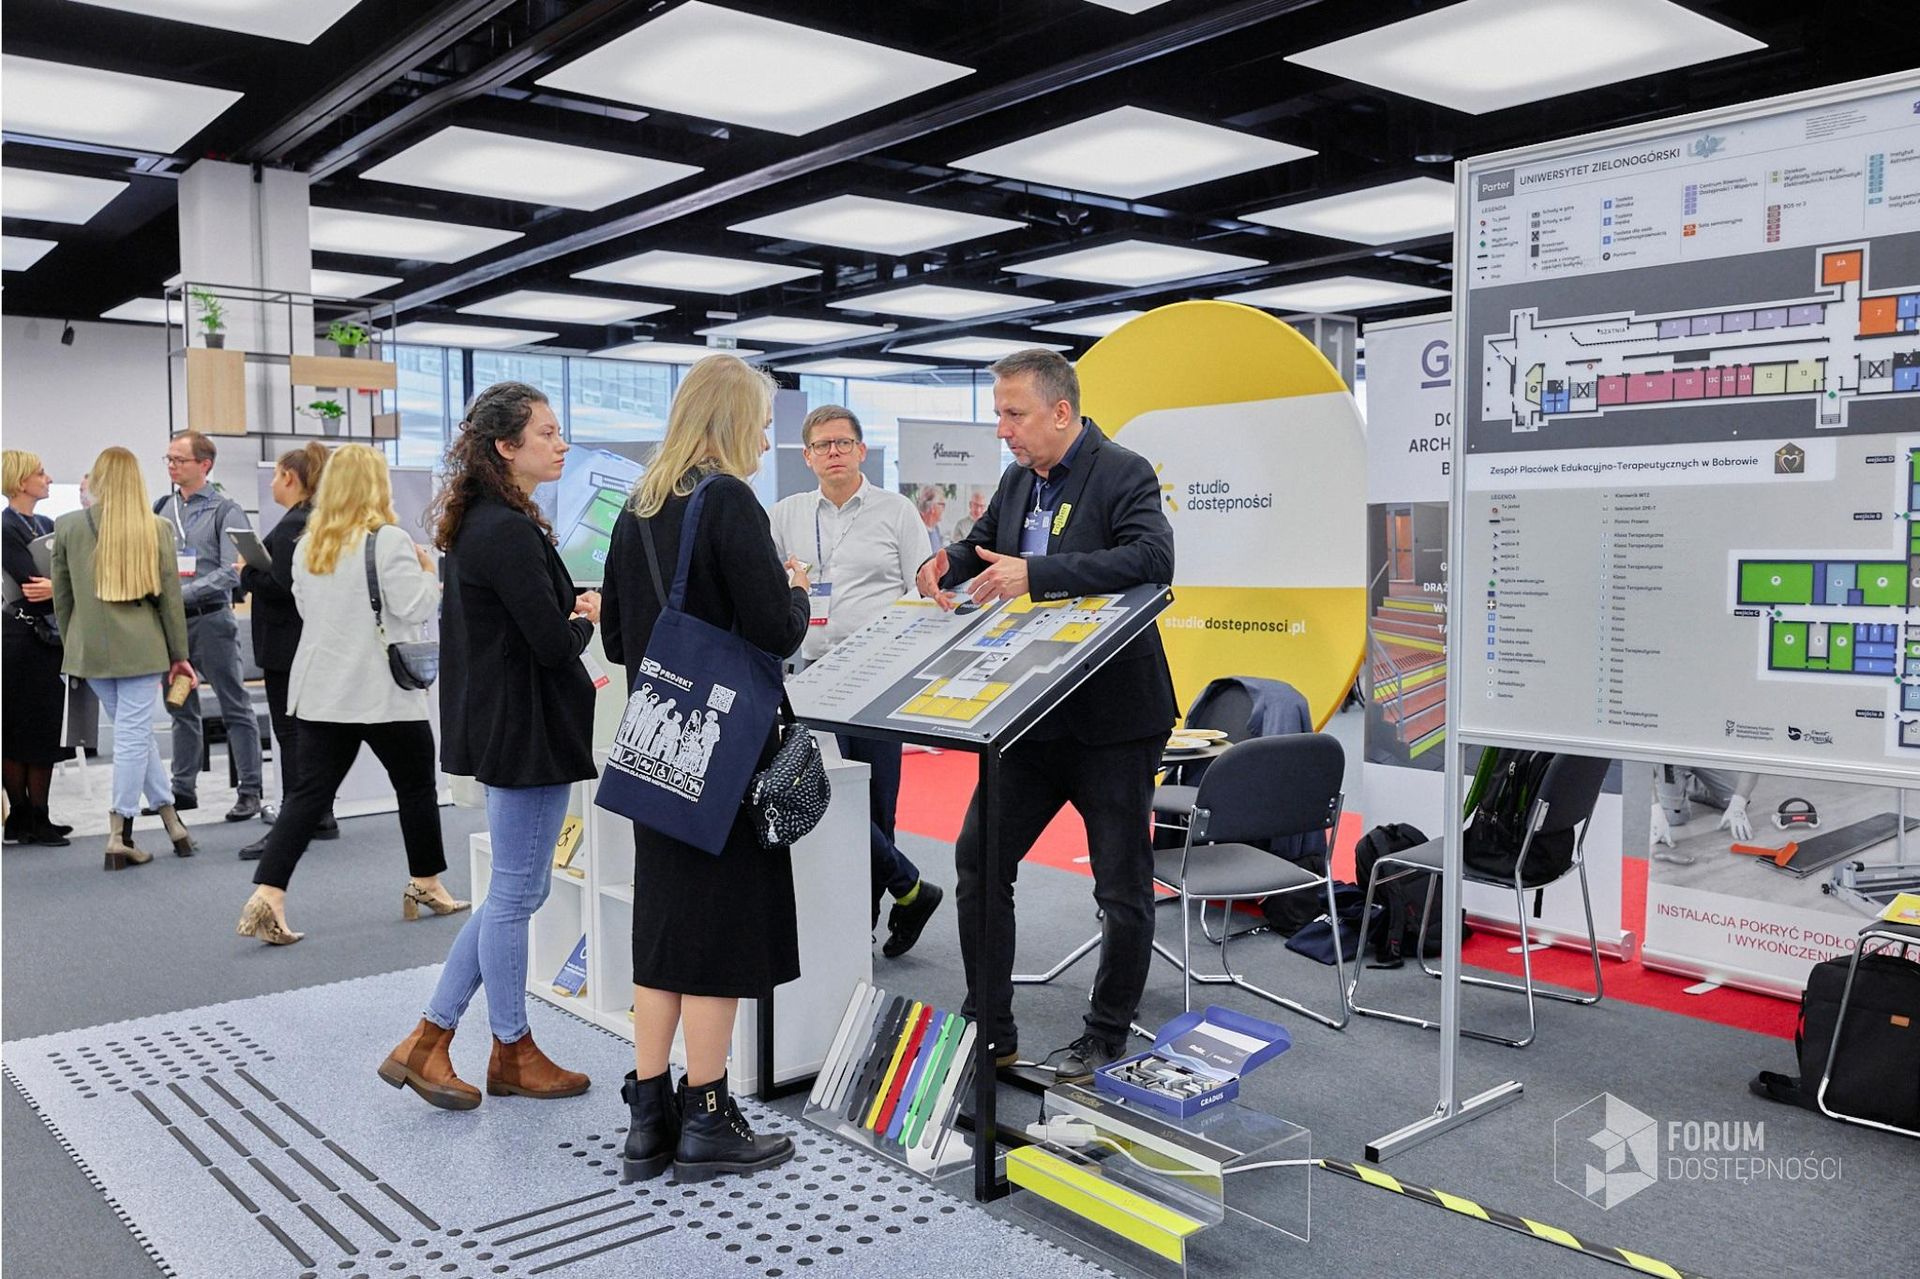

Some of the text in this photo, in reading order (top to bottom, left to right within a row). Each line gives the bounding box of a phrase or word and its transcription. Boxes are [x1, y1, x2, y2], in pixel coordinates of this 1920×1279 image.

[1520, 148, 1680, 186] UNIWERSYTET ZIELONOGÓRSKI
[1482, 181, 1510, 193] Parter
[1490, 465, 1518, 475] Zespół
[1520, 464, 1558, 474] Placówek
[1561, 458, 1699, 473] Edukacyjno-Terapeutycznych
[1712, 456, 1758, 467] Bobrowie
[1188, 479, 1230, 494] studio
[1188, 493, 1272, 514] dostępności
[1164, 616, 1306, 634] studiodostepnosci.pl
[660, 669, 694, 688] PROJEKT
[1657, 903, 1736, 928] INSTALACJA
[1740, 917, 1800, 941] POKRYĆ
[1727, 933, 1839, 962] I WYKOŃCZENI
